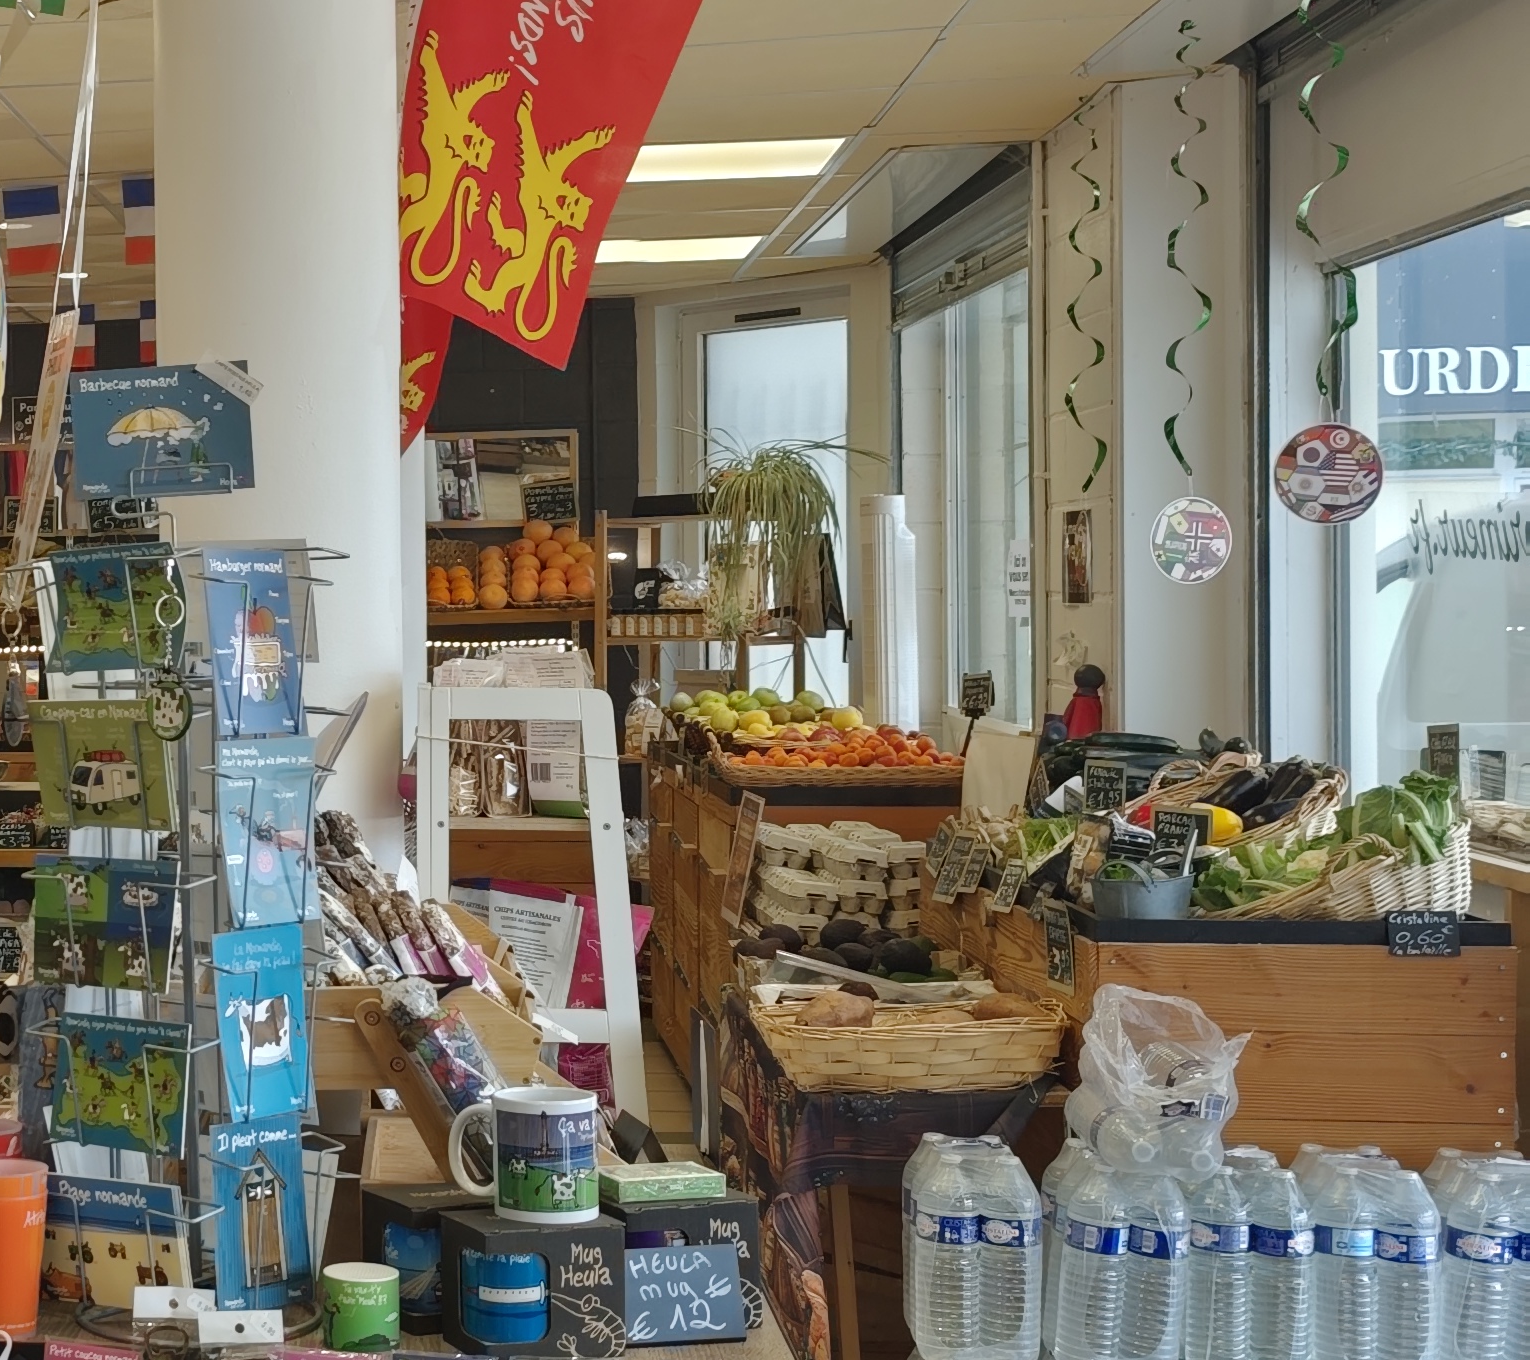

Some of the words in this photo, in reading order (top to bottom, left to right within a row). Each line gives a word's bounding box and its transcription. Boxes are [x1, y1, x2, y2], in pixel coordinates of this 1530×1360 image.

[79, 377, 132, 393] Barbecue
[134, 372, 179, 389] normand
[209, 559, 251, 576] Hamburger
[494, 905, 513, 915] CHIPS
[515, 908, 562, 923] ARTISANALES
[1388, 913, 1449, 926] Cristaline
[558, 1117, 575, 1138] Ça
[579, 1120, 591, 1131] va
[232, 1130, 258, 1153] pleut
[95, 1191, 147, 1209] normande
[710, 1217, 741, 1240] Mug
[571, 1243, 603, 1266] Mug
[560, 1265, 613, 1289] Heula
[628, 1311, 658, 1341] €
[670, 1299, 727, 1332] 12
[49, 1344, 72, 1358] Petit
